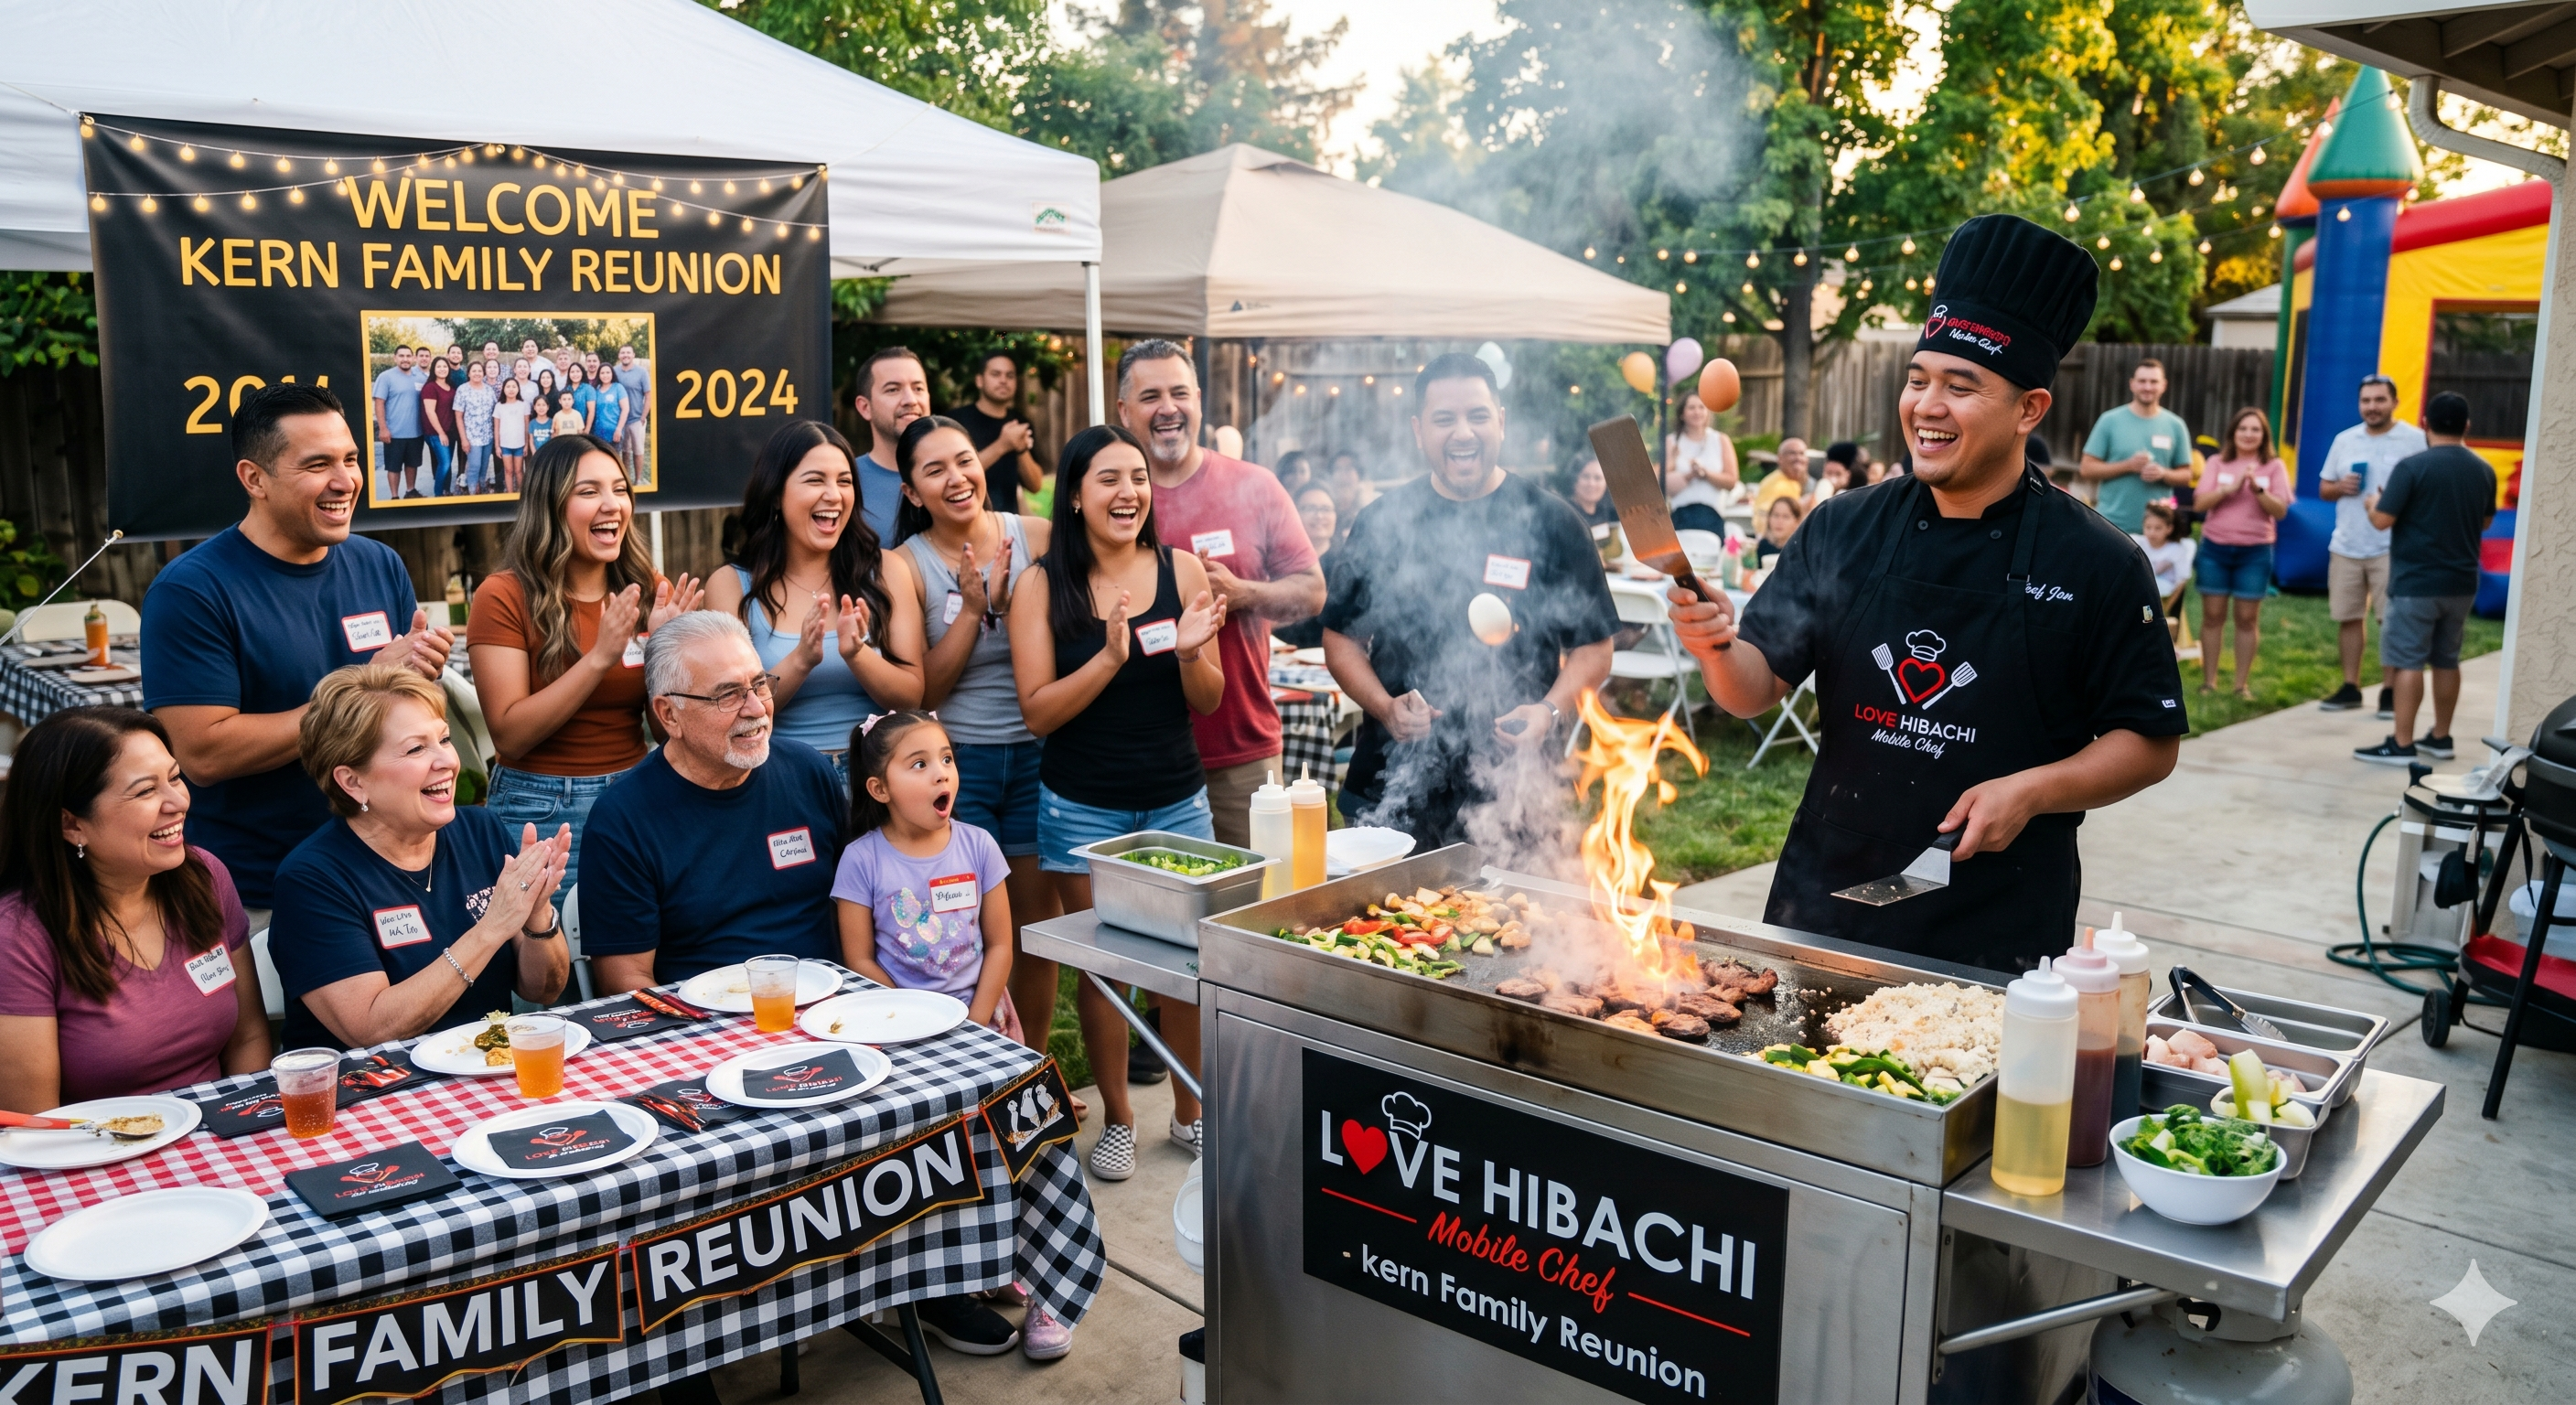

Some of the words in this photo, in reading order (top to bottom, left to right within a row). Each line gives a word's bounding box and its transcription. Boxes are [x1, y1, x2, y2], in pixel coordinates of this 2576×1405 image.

[344, 175, 660, 239] WELCOME
[179, 236, 339, 289] KERN
[362, 242, 553, 292] FAMILY
[571, 248, 781, 295] REUNION
[183, 374, 329, 434] 20
[675, 368, 799, 419] 2024
[2045, 585, 2074, 602] Jon
[1854, 702, 1898, 728] LOVE
[1899, 714, 1977, 744] HIBACHI
[1914, 736, 1947, 760] Chef
[1482, 1159, 1756, 1300] HIBACHI
[312, 1260, 610, 1392] FAMILY
[647, 1129, 967, 1303] REUNION
[1426, 1210, 1530, 1273] Mobile
[1537, 1246, 1616, 1314] Chef
[1361, 1243, 1430, 1297] kern
[1440, 1271, 1548, 1345] Family
[1560, 1314, 1706, 1399] Reunion
